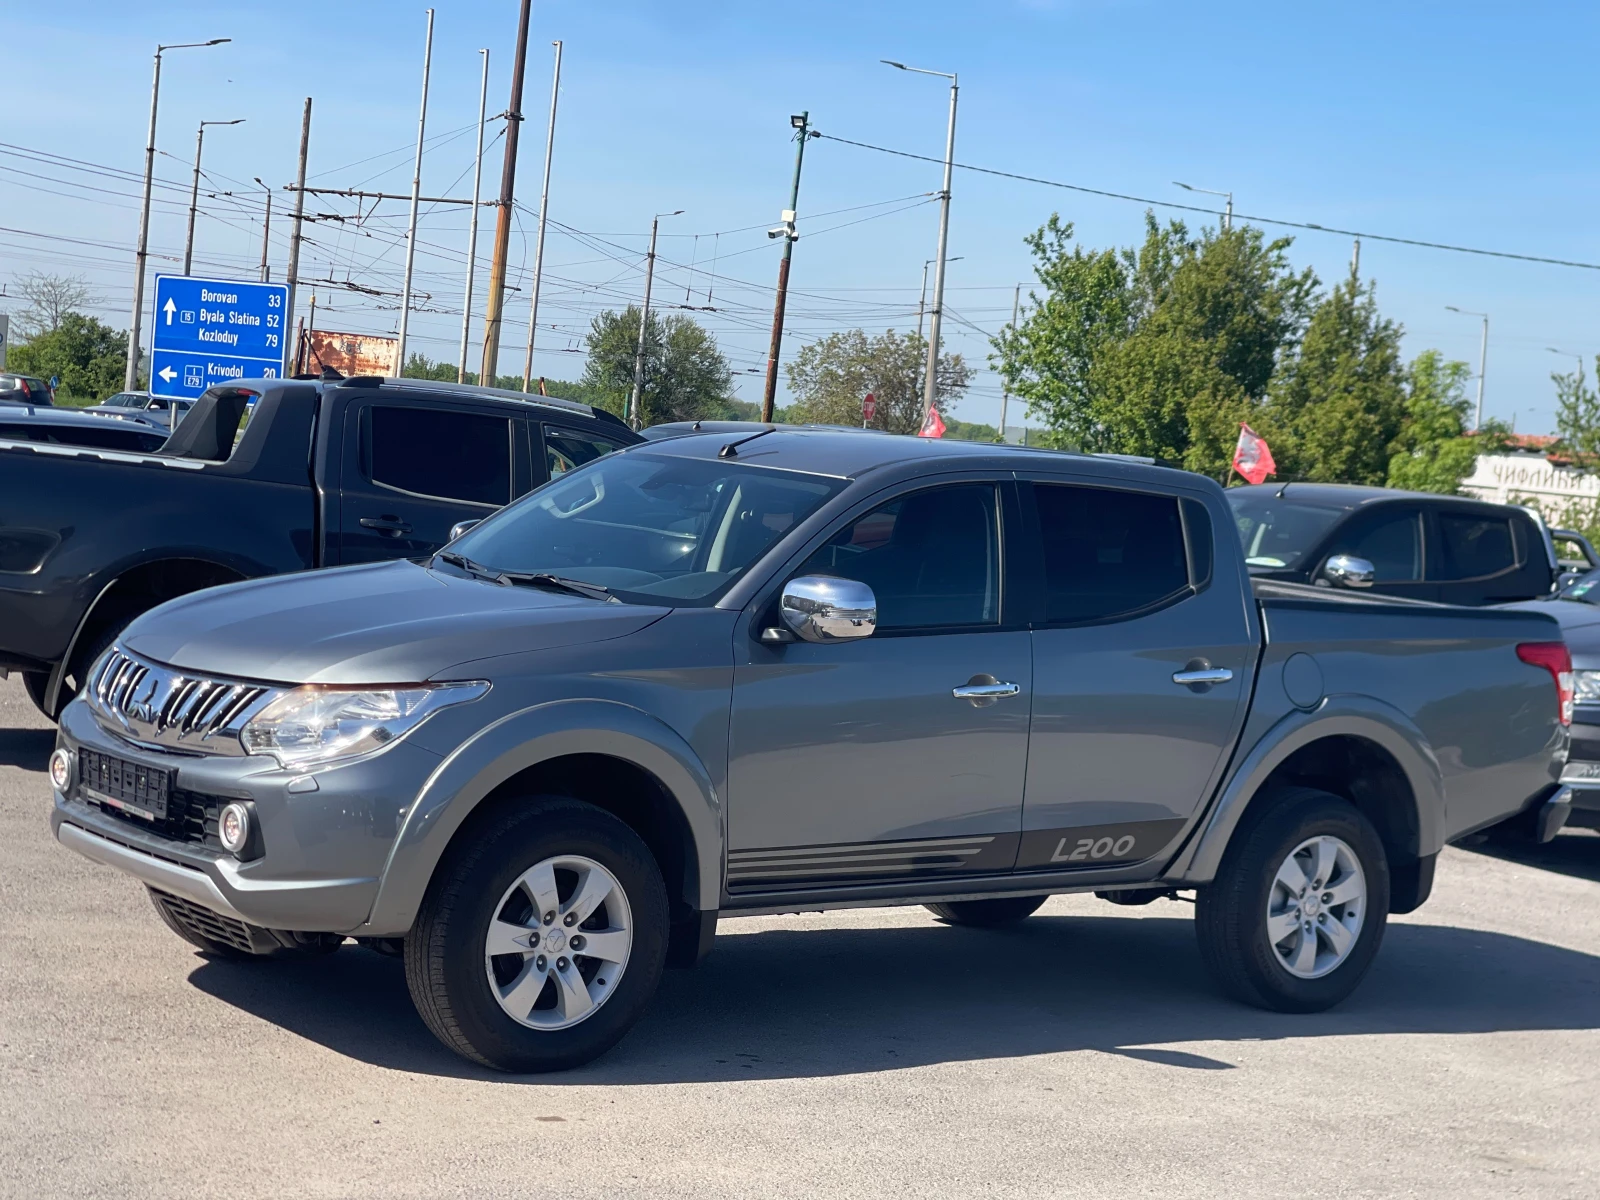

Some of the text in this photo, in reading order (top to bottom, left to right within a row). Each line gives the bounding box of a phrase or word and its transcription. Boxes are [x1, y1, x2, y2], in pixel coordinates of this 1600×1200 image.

[201, 288, 281, 308] Borovan 33
[184, 308, 280, 328] 15 Byala Slatina 52
[198, 327, 278, 347] Kozloduy 79
[207, 362, 244, 378] Krivodol
[263, 367, 276, 379] 20
[187, 377, 200, 386] E79
[1050, 834, 1136, 863] L200
